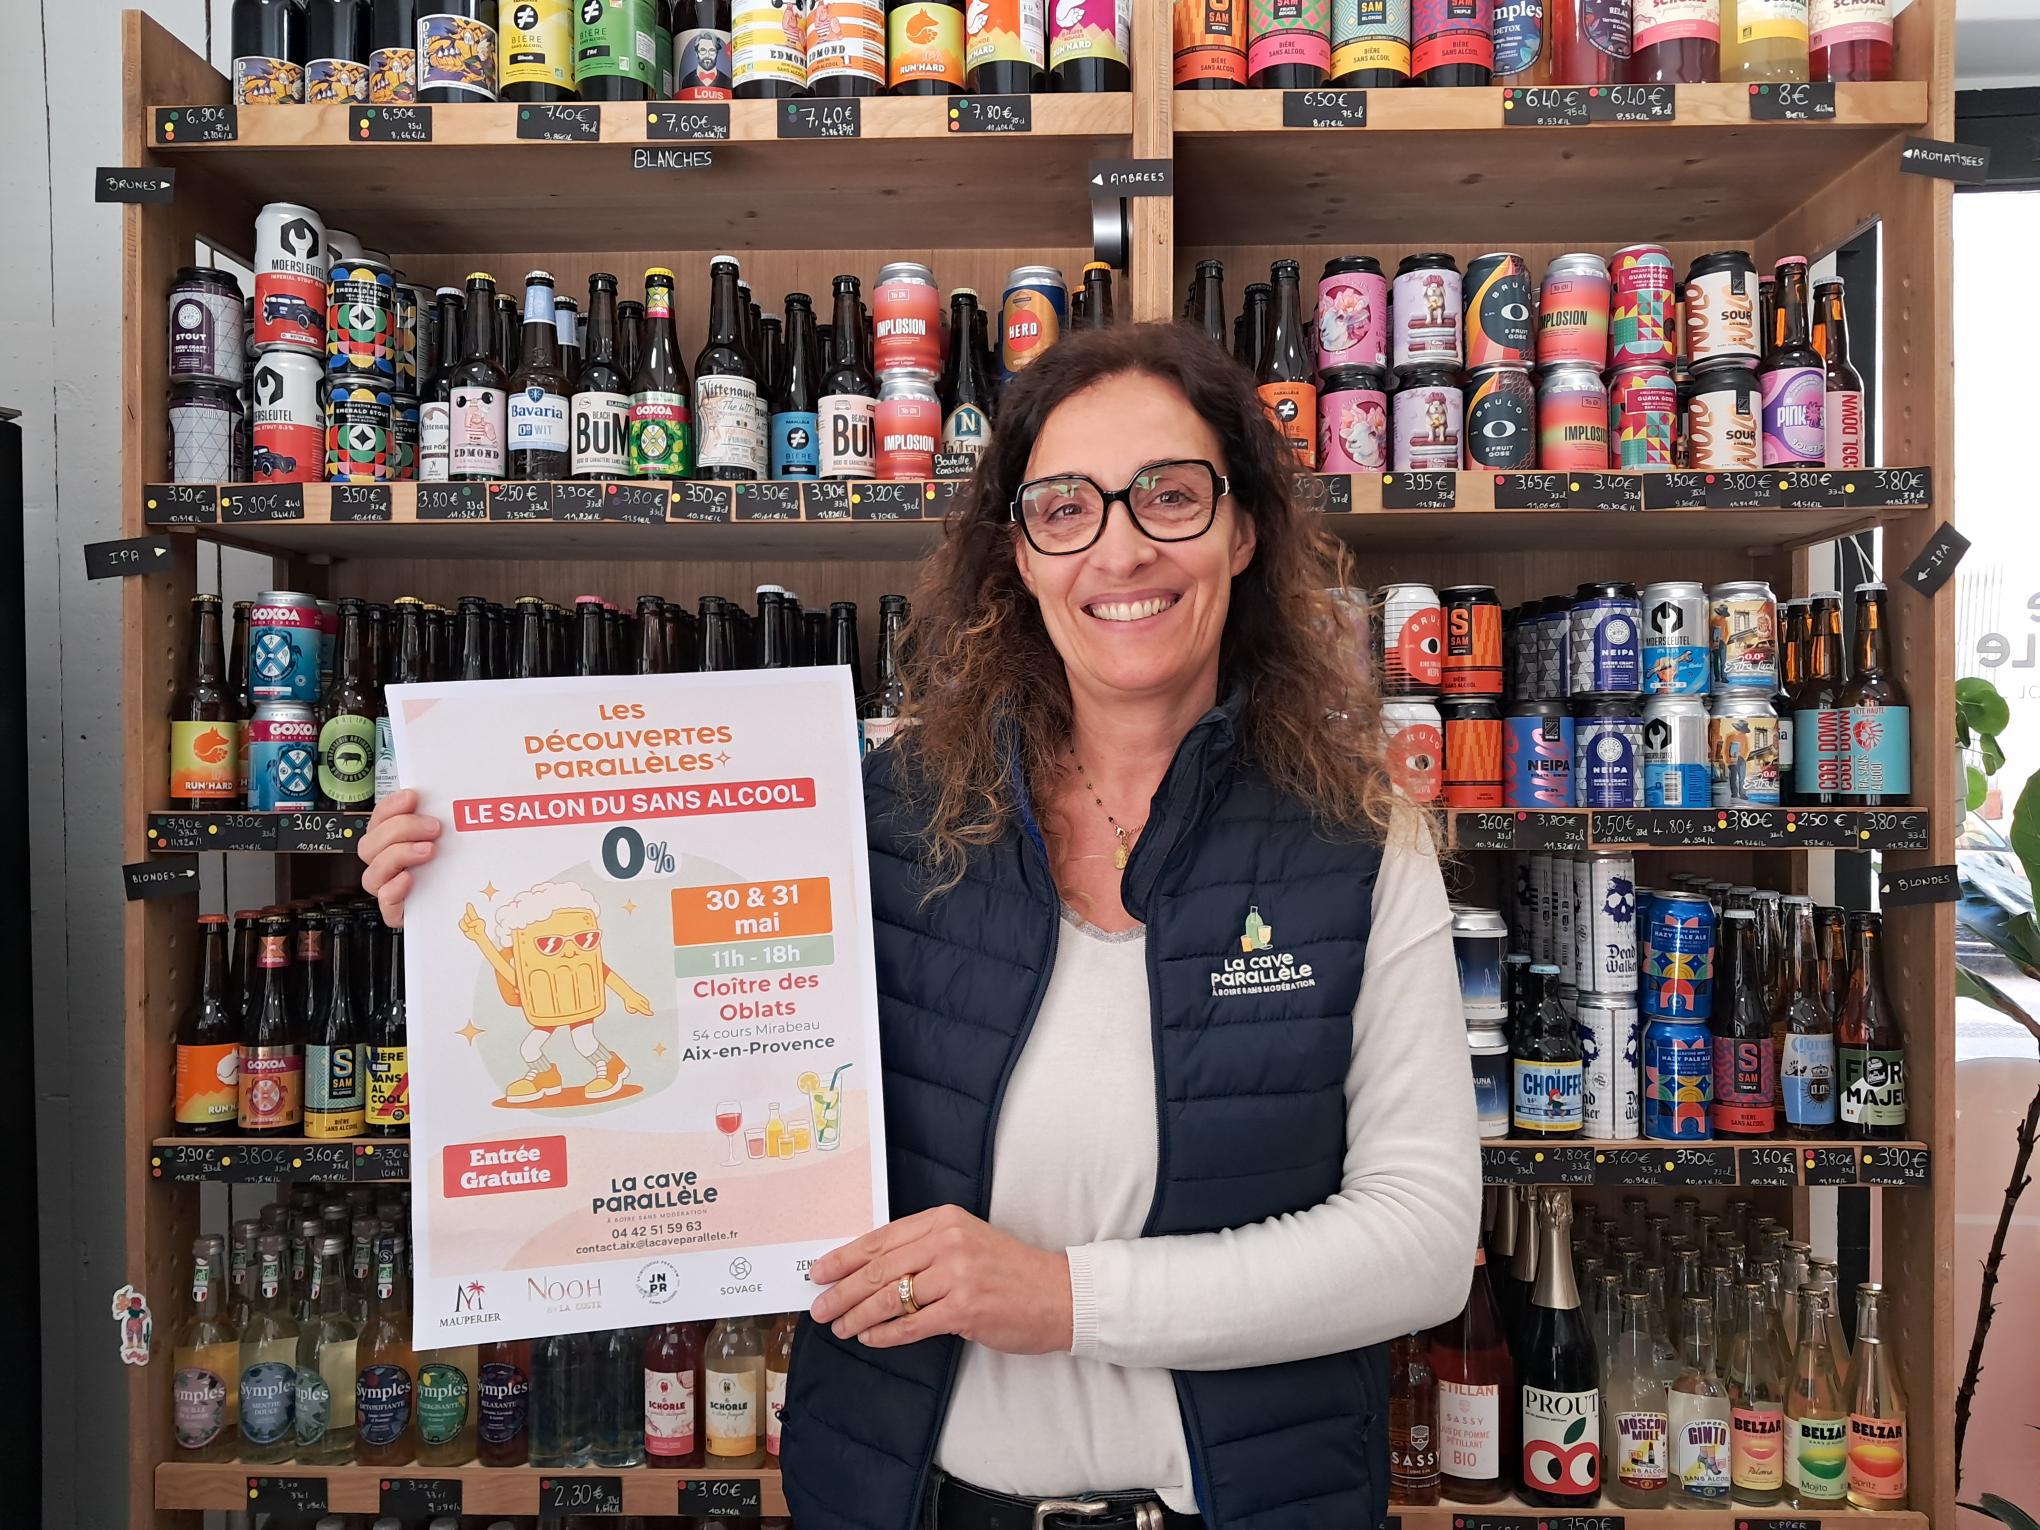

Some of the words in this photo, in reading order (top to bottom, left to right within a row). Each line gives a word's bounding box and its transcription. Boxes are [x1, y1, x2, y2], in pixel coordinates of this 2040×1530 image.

[1361, 1, 1383, 13] SAM
[1209, 11, 1229, 24] SAM
[900, 62, 945, 75] RUN'HARD
[633, 149, 712, 169] BLANCHES
[106, 176, 157, 191] BRUNES
[1720, 310, 1752, 322] SOUR
[877, 319, 926, 338] IMPLOSION
[1008, 321, 1039, 339] HERO
[175, 333, 207, 341] STOUT
[511, 404, 563, 420] Bavaria
[592, 411, 610, 420] BEACH
[1841, 394, 1859, 435] DOWN
[883, 434, 935, 452] IMPLOSION
[1726, 430, 1756, 441] SOUR
[454, 448, 500, 460] EDMOND
[108, 549, 139, 565] IPA
[1931, 541, 1952, 567] IPA
[251, 606, 301, 622] GOXOA
[1450, 636, 1469, 646] SAM
[1602, 648, 1635, 657] NEIPA
[1818, 711, 1839, 752] DOWN
[1528, 759, 1571, 772] NEIPA
[1593, 766, 1628, 774] NEIPA
[1818, 755, 1839, 790] COOL
[185, 781, 233, 792] RUN'HARD
[464, 803, 494, 825] LE
[499, 799, 585, 823] SALON
[591, 795, 626, 816] DU
[631, 790, 701, 814] SANS
[707, 783, 804, 808] ALCOOL
[132, 871, 176, 883] BLONDES
[1898, 873, 1951, 891] BLONDES
[706, 888, 740, 911] 30
[746, 886, 766, 908] &
[771, 883, 800, 906] 31
[735, 911, 780, 935] mai
[712, 949, 745, 969] 11h
[763, 944, 801, 965] 18h
[1605, 943, 1636, 960] Dead
[1249, 952, 1294, 970] cave
[693, 977, 771, 998] Cloître
[778, 972, 820, 991] des
[1218, 986, 1242, 996] BOIRE
[1263, 978, 1316, 993] MODÉRATION
[719, 1000, 797, 1022] Oblats
[692, 1029, 710, 1042] 54
[713, 1026, 752, 1040] cours
[755, 1019, 821, 1036] Mirabeau
[682, 1036, 836, 1062] Aix-en-Provence
[247, 1058, 288, 1070] GOXOA
[333, 1078, 353, 1089] SAM
[371, 1073, 402, 1084] SANS
[1523, 1073, 1583, 1097] CHOUFFE
[1738, 1072, 1758, 1083] SAM
[371, 1085, 385, 1094] AL
[371, 1095, 404, 1104] COOL
[470, 1145, 541, 1167] Entrée
[460, 1165, 552, 1190] Gratuite
[643, 1170, 698, 1190] cave
[611, 1228, 628, 1240] 04
[631, 1226, 647, 1238] 42
[650, 1225, 663, 1235] 51
[667, 1222, 683, 1234] 59
[686, 1220, 702, 1232] 63
[649, 1273, 666, 1284] JN
[650, 1283, 667, 1293] PR
[720, 1283, 764, 1296] SOVAGE
[439, 1312, 502, 1328] MAUPERIER
[356, 1381, 412, 1401] Symples
[648, 1400, 685, 1411] SCHORLE
[710, 1401, 748, 1411] SCHORLE
[1524, 1388, 1599, 1416] PROUT
[1447, 1413, 1484, 1426] SASSY
[1631, 1430, 1660, 1441] MULE
[1391, 1451, 1440, 1468] SASSY
[1453, 1451, 1477, 1467] BIO
[1801, 1480, 1828, 1493] Mojito
[1852, 1477, 1876, 1490] Spritz
